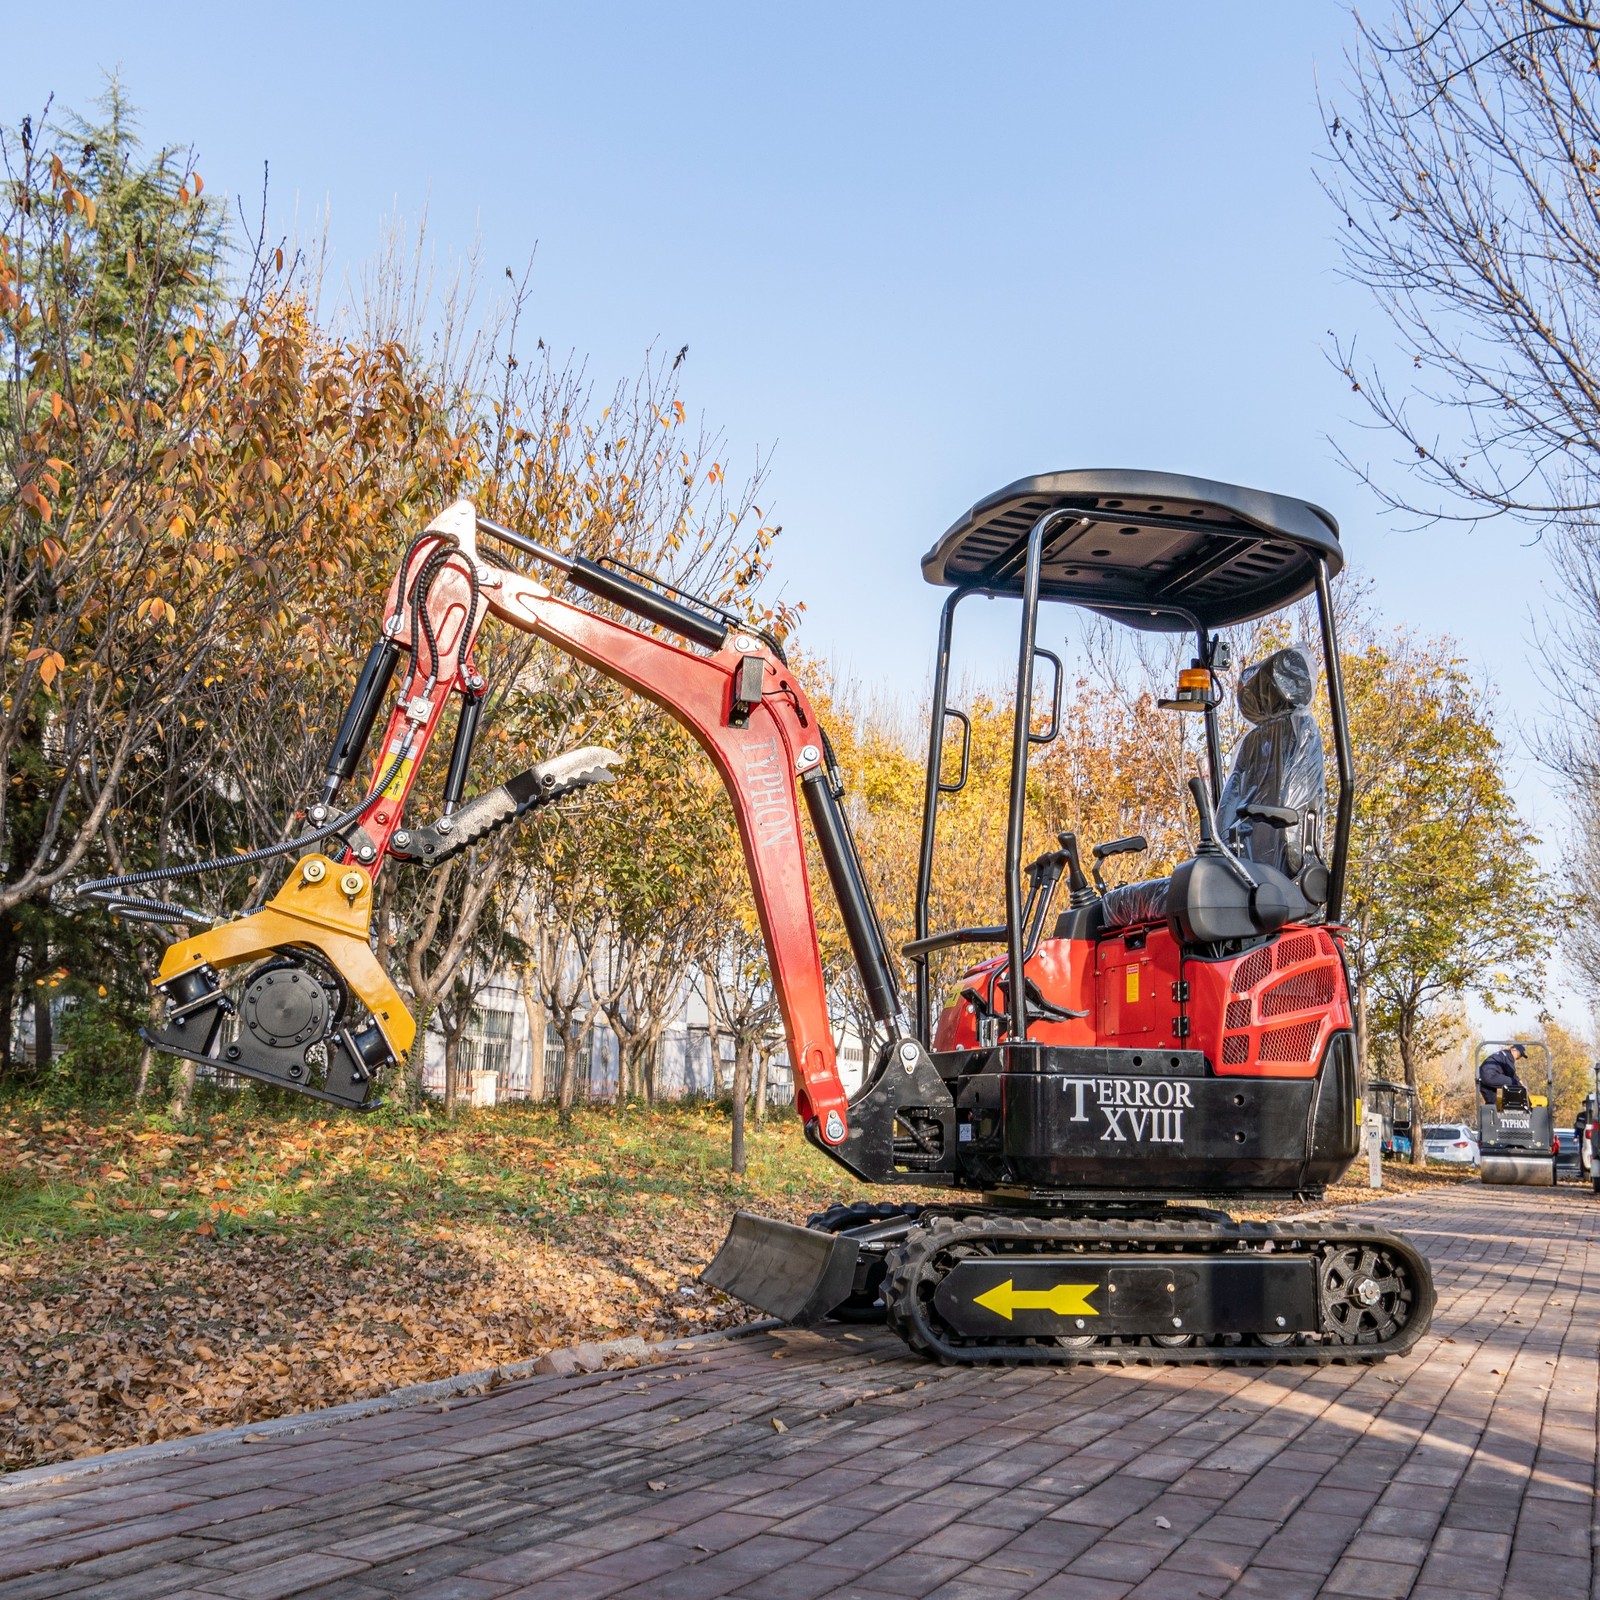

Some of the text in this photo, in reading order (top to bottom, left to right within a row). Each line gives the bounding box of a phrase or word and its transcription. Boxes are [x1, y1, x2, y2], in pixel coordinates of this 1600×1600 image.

[742, 735, 795, 847] TYPHON
[1062, 1077, 1195, 1122] TERROR
[1100, 1106, 1184, 1143] XVIII
[1500, 1119, 1530, 1129] TYPHON
